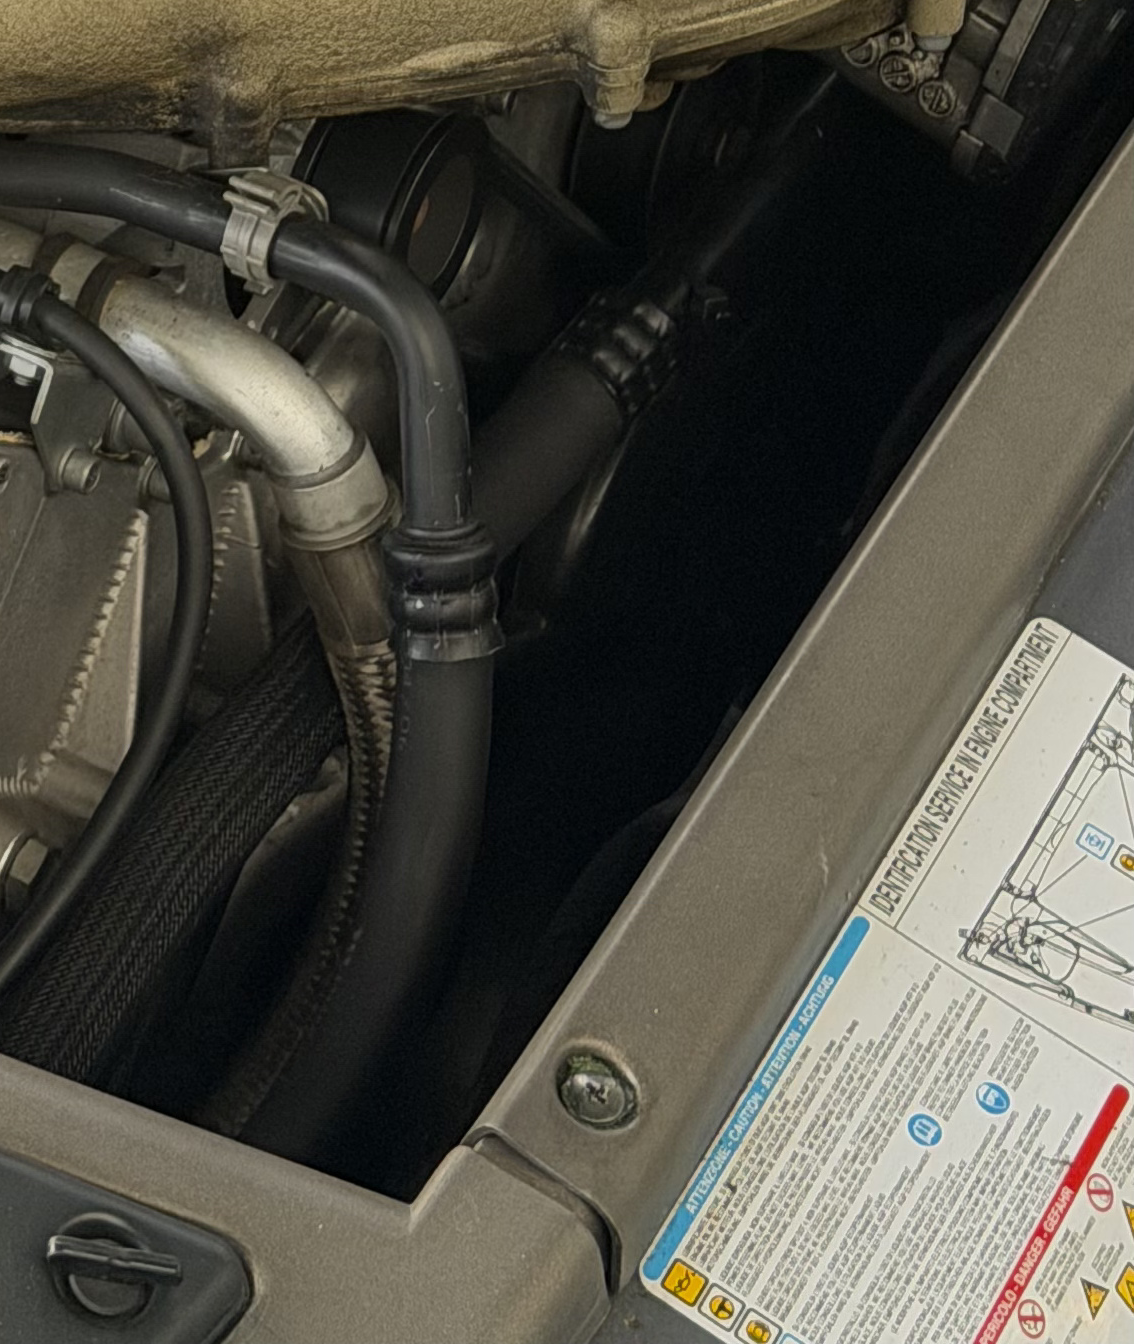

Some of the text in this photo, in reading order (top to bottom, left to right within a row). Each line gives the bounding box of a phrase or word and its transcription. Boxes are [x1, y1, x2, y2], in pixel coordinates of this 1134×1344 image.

[868, 622, 1059, 916] IDENTIFICATION SERVICE IN ENGINE COMPARTMENT
[729, 1093, 763, 1140] CAUTION
[761, 1031, 800, 1088] ATTENTION
[799, 974, 834, 1026] ACHTUNG
[1014, 1237, 1047, 1285] DANGER
[1043, 1185, 1074, 1231] GEFAHR
